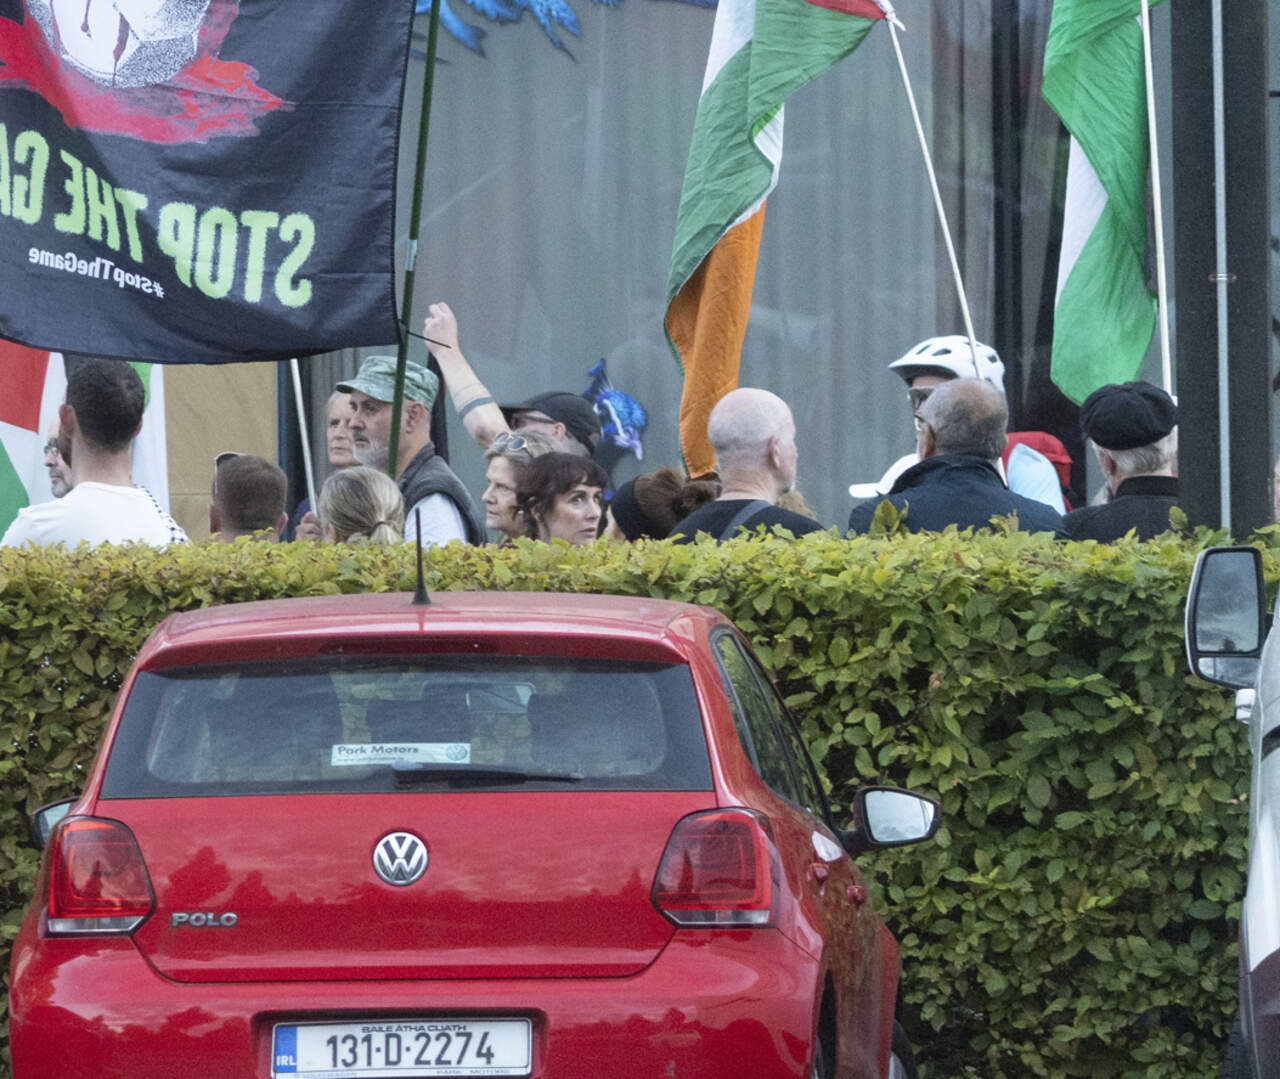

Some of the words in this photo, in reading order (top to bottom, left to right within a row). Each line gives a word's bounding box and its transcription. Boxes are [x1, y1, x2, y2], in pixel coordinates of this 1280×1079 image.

[337, 745, 368, 755] Park
[370, 745, 420, 754] Motors
[170, 911, 238, 928] POLO
[361, 1025, 394, 1033] BAILE
[427, 1024, 467, 1032] CLIATH
[276, 1056, 297, 1066] IRL
